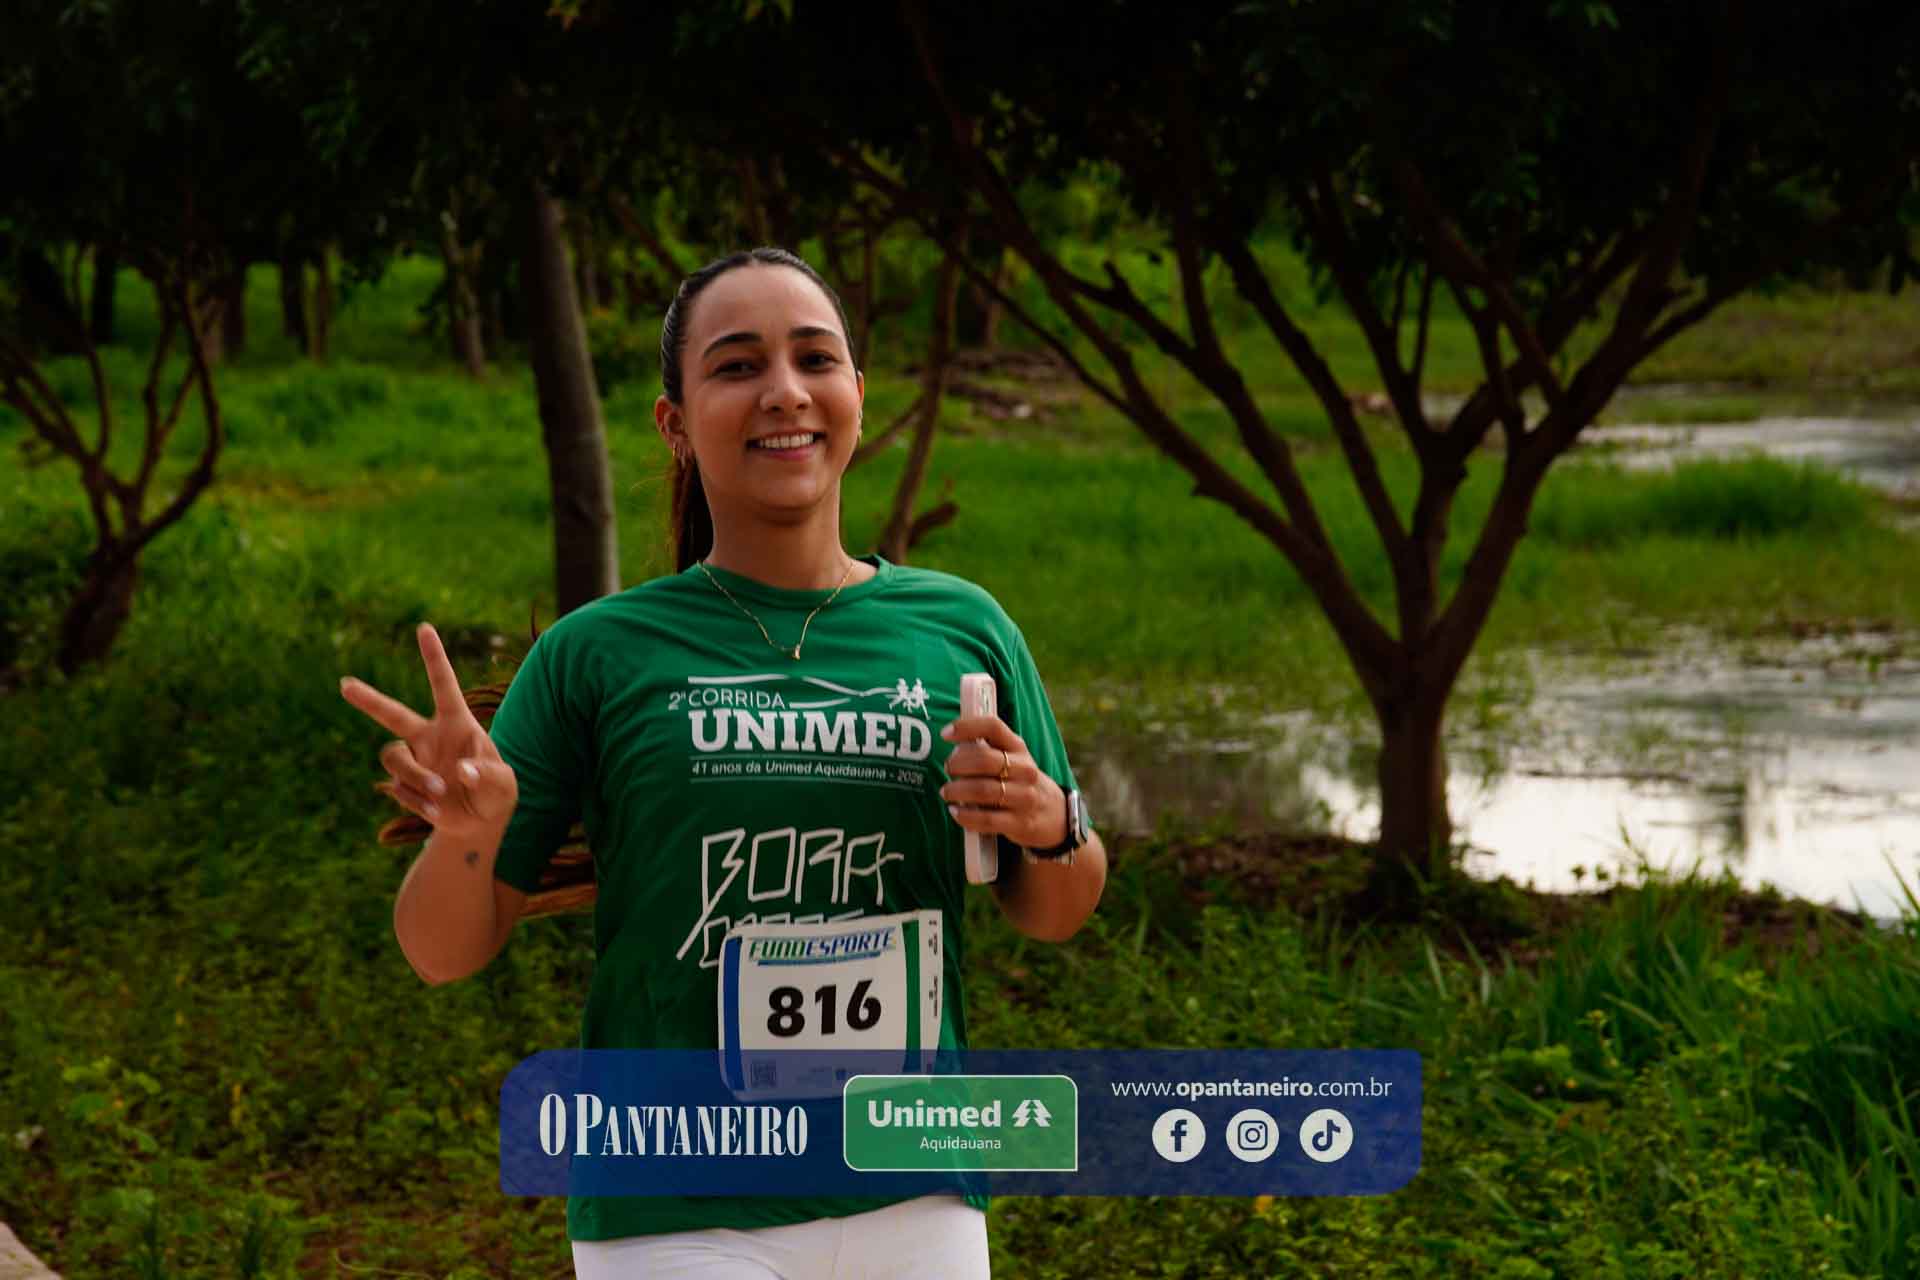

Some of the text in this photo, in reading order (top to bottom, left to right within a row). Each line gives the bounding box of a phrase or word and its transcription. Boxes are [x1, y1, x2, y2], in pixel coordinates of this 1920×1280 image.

[688, 687, 786, 710] CORRIDA
[688, 708, 932, 761] UNIMED
[692, 761, 707, 775] 41
[711, 762, 742, 775] anos
[745, 761, 761, 774] da
[765, 760, 812, 775] Unimed
[815, 762, 887, 780] Aquidauana
[676, 827, 904, 960] BORA
[748, 927, 896, 960] FUNDESPORTE
[766, 979, 882, 1038] 816
